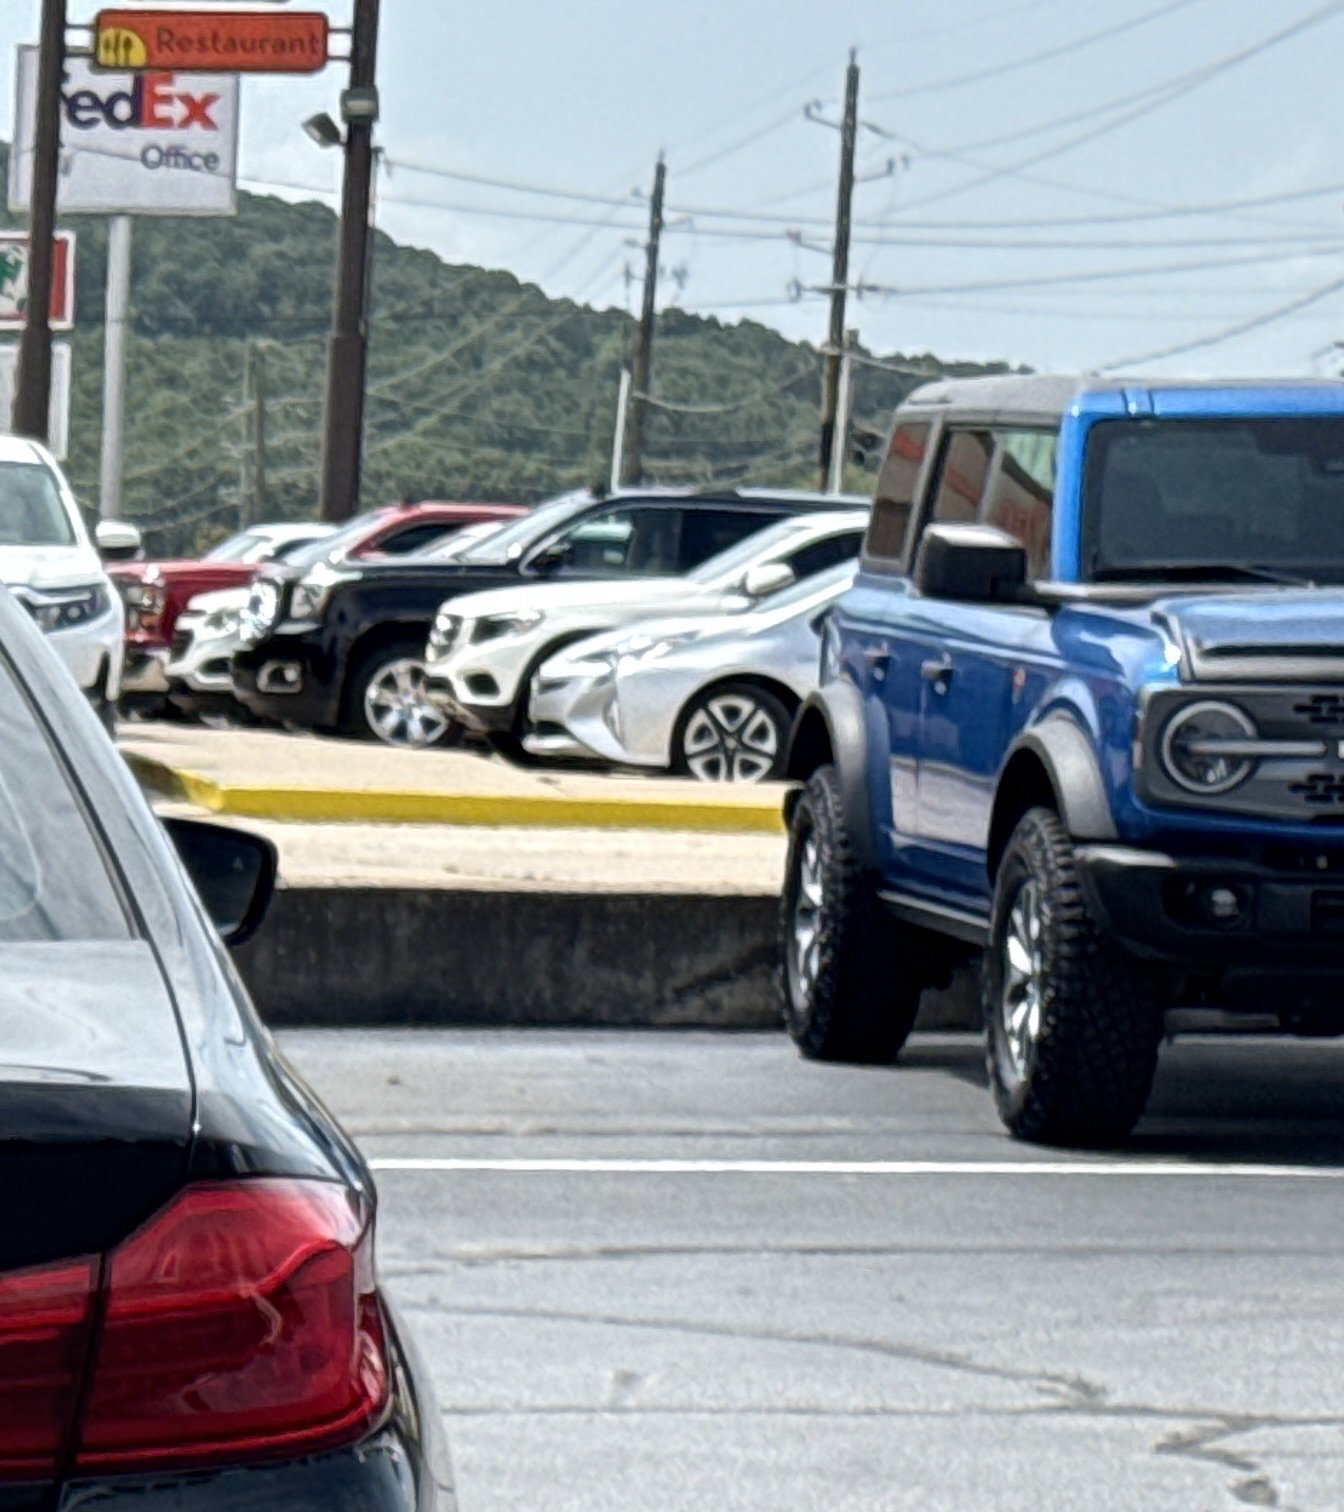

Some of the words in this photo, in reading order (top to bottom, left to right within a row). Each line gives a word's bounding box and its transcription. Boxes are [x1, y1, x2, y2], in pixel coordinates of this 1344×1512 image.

[155, 26, 319, 55] Restaurant
[59, 70, 219, 130] edEx
[141, 144, 220, 171] Office
